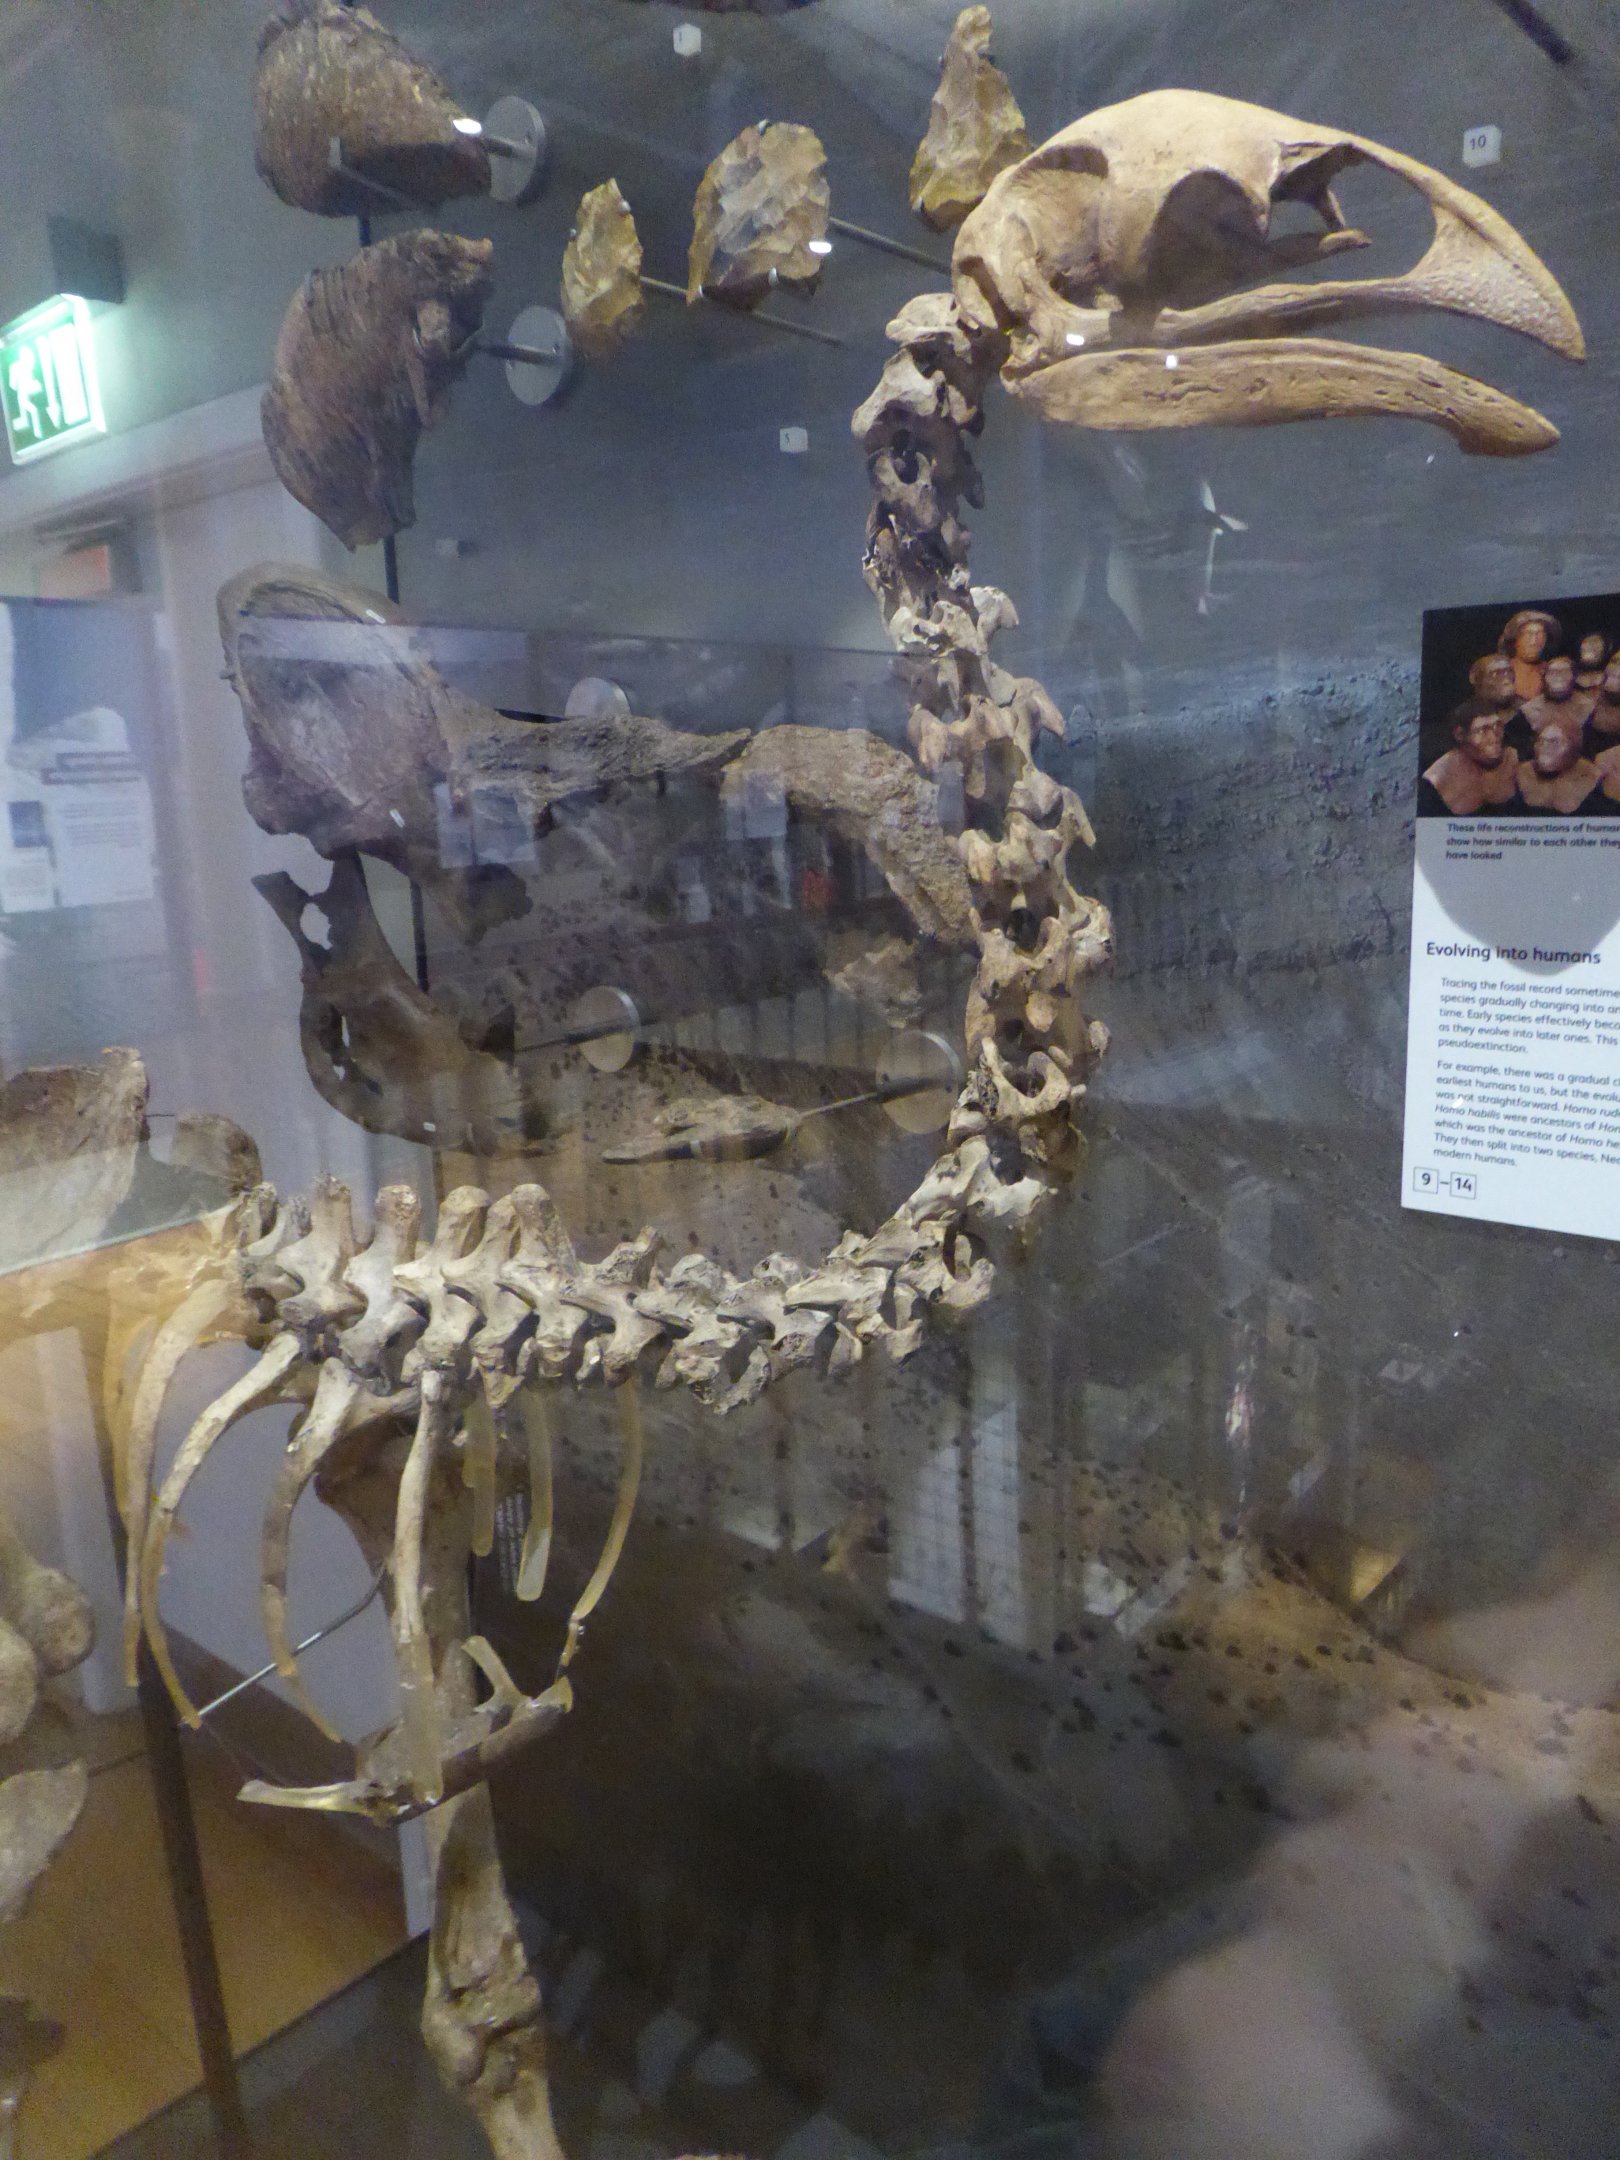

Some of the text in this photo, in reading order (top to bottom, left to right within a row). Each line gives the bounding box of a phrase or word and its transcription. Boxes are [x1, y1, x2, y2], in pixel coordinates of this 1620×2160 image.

[1469, 135, 1487, 150] 10
[1426, 941, 1601, 964] Evolving into humans
[1421, 1172, 1431, 1185] 9
[1455, 1176, 1472, 1192] 14
